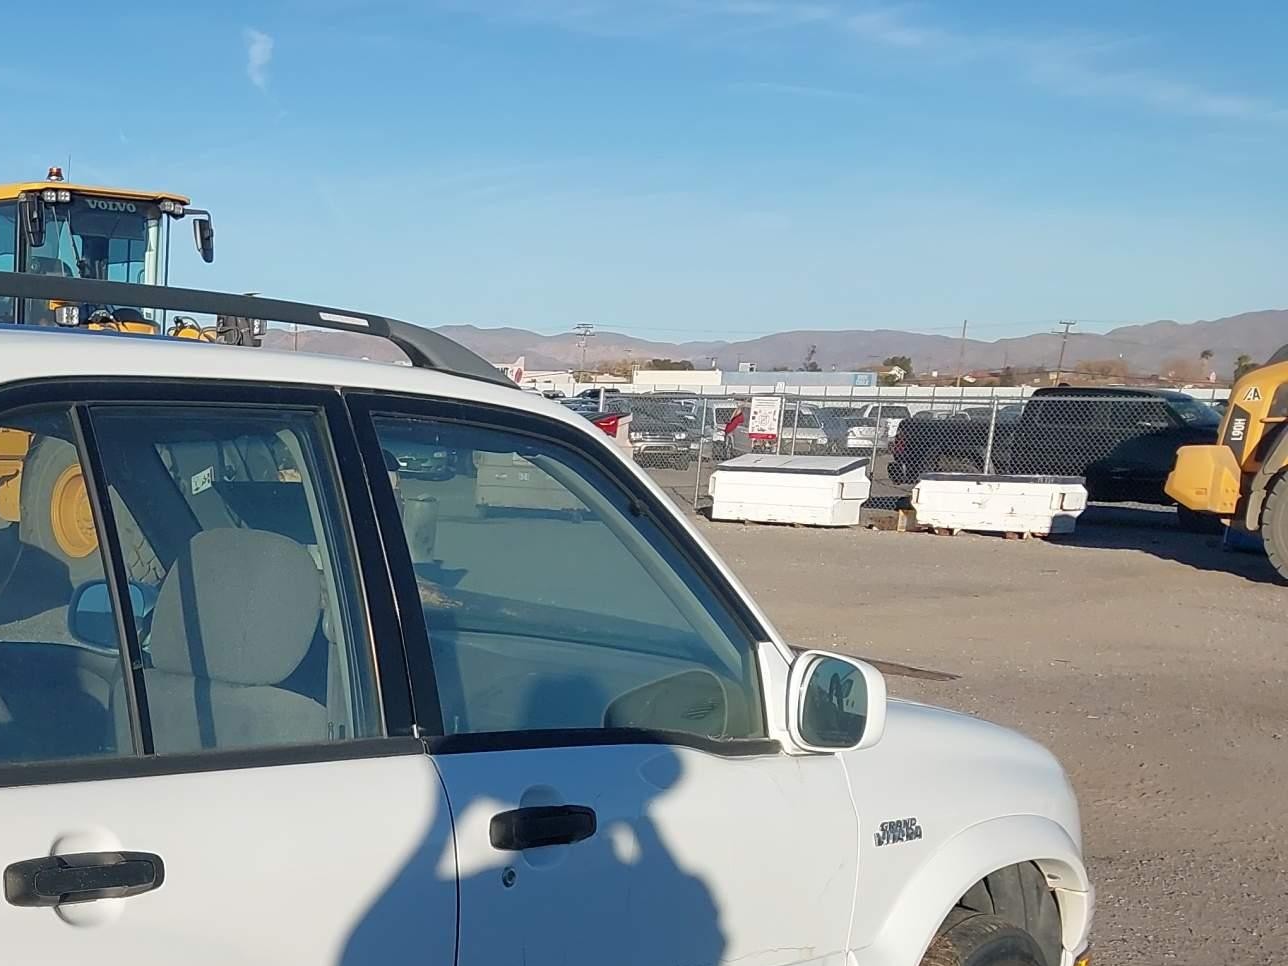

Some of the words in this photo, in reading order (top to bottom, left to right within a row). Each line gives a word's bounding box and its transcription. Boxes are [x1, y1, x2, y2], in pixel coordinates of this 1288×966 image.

[85, 199, 137, 213] VOLVO
[1231, 418, 1247, 441] L90H
[880, 817, 917, 832] GRAND
